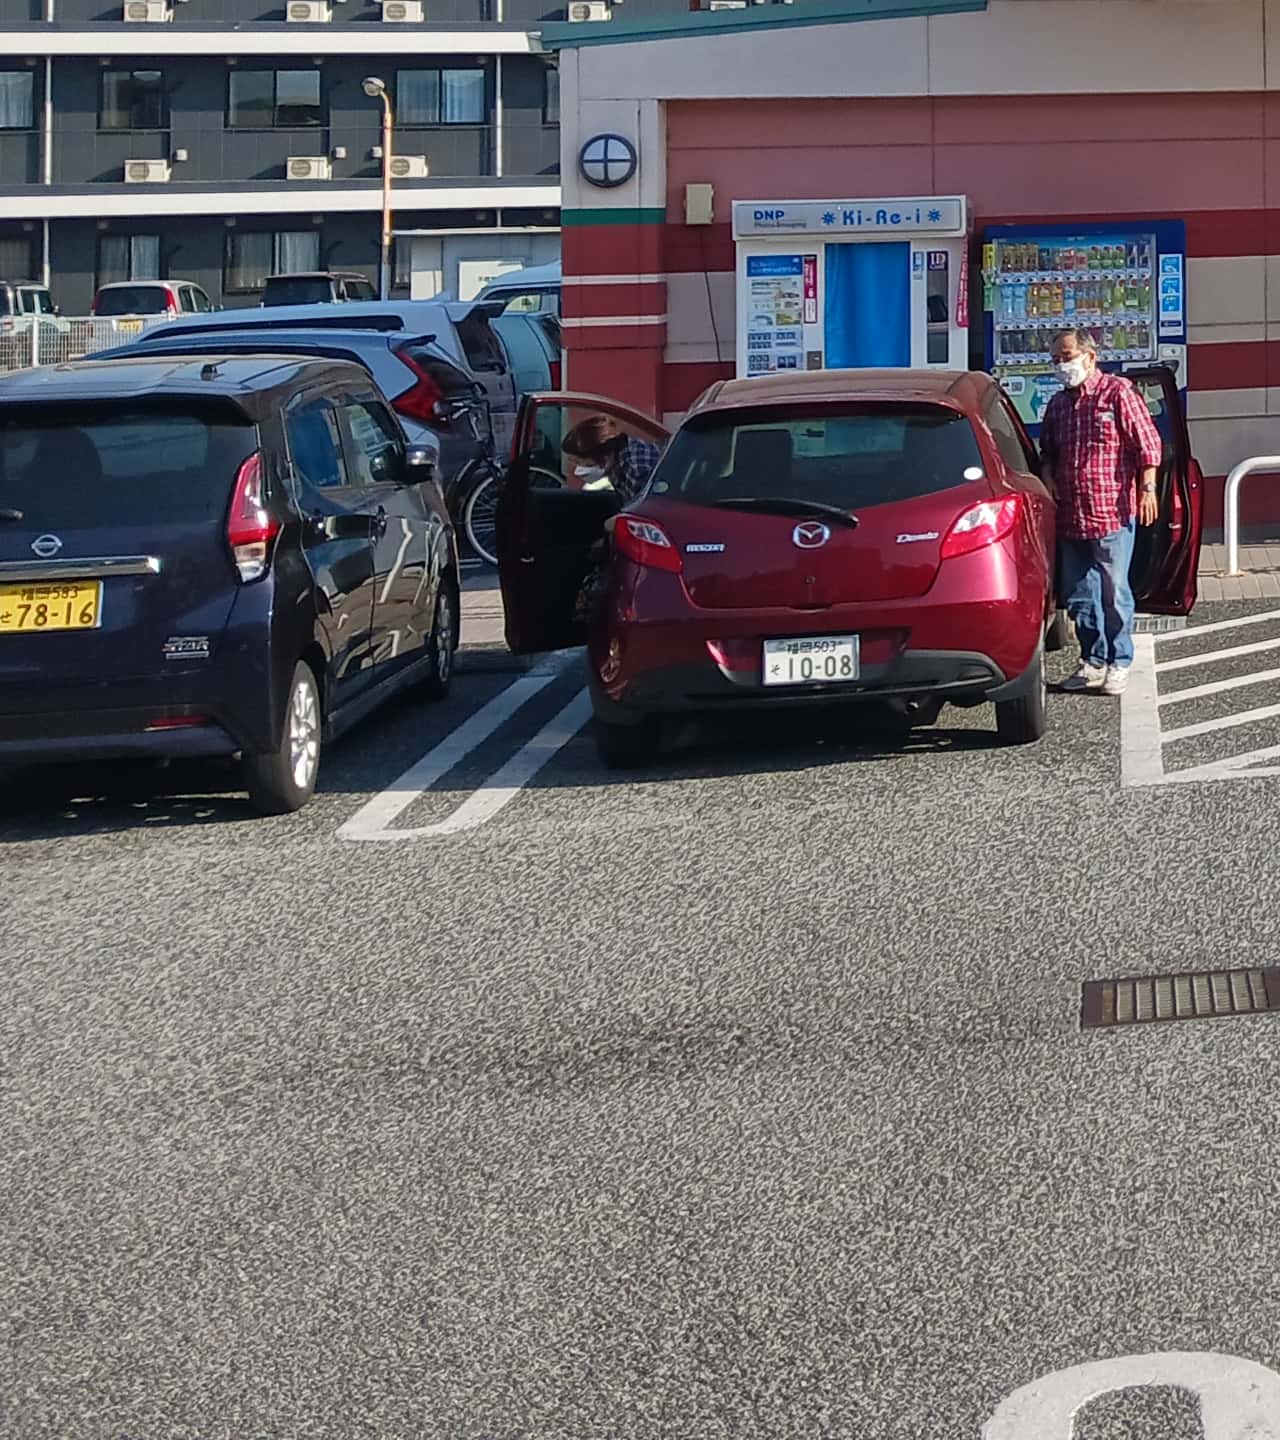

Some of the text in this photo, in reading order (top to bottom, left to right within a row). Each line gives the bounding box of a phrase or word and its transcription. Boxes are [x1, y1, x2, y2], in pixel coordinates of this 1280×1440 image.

[753, 210, 785, 220] DNP
[17, 601, 94, 628] 78-16
[789, 655, 852, 679] 10-08
